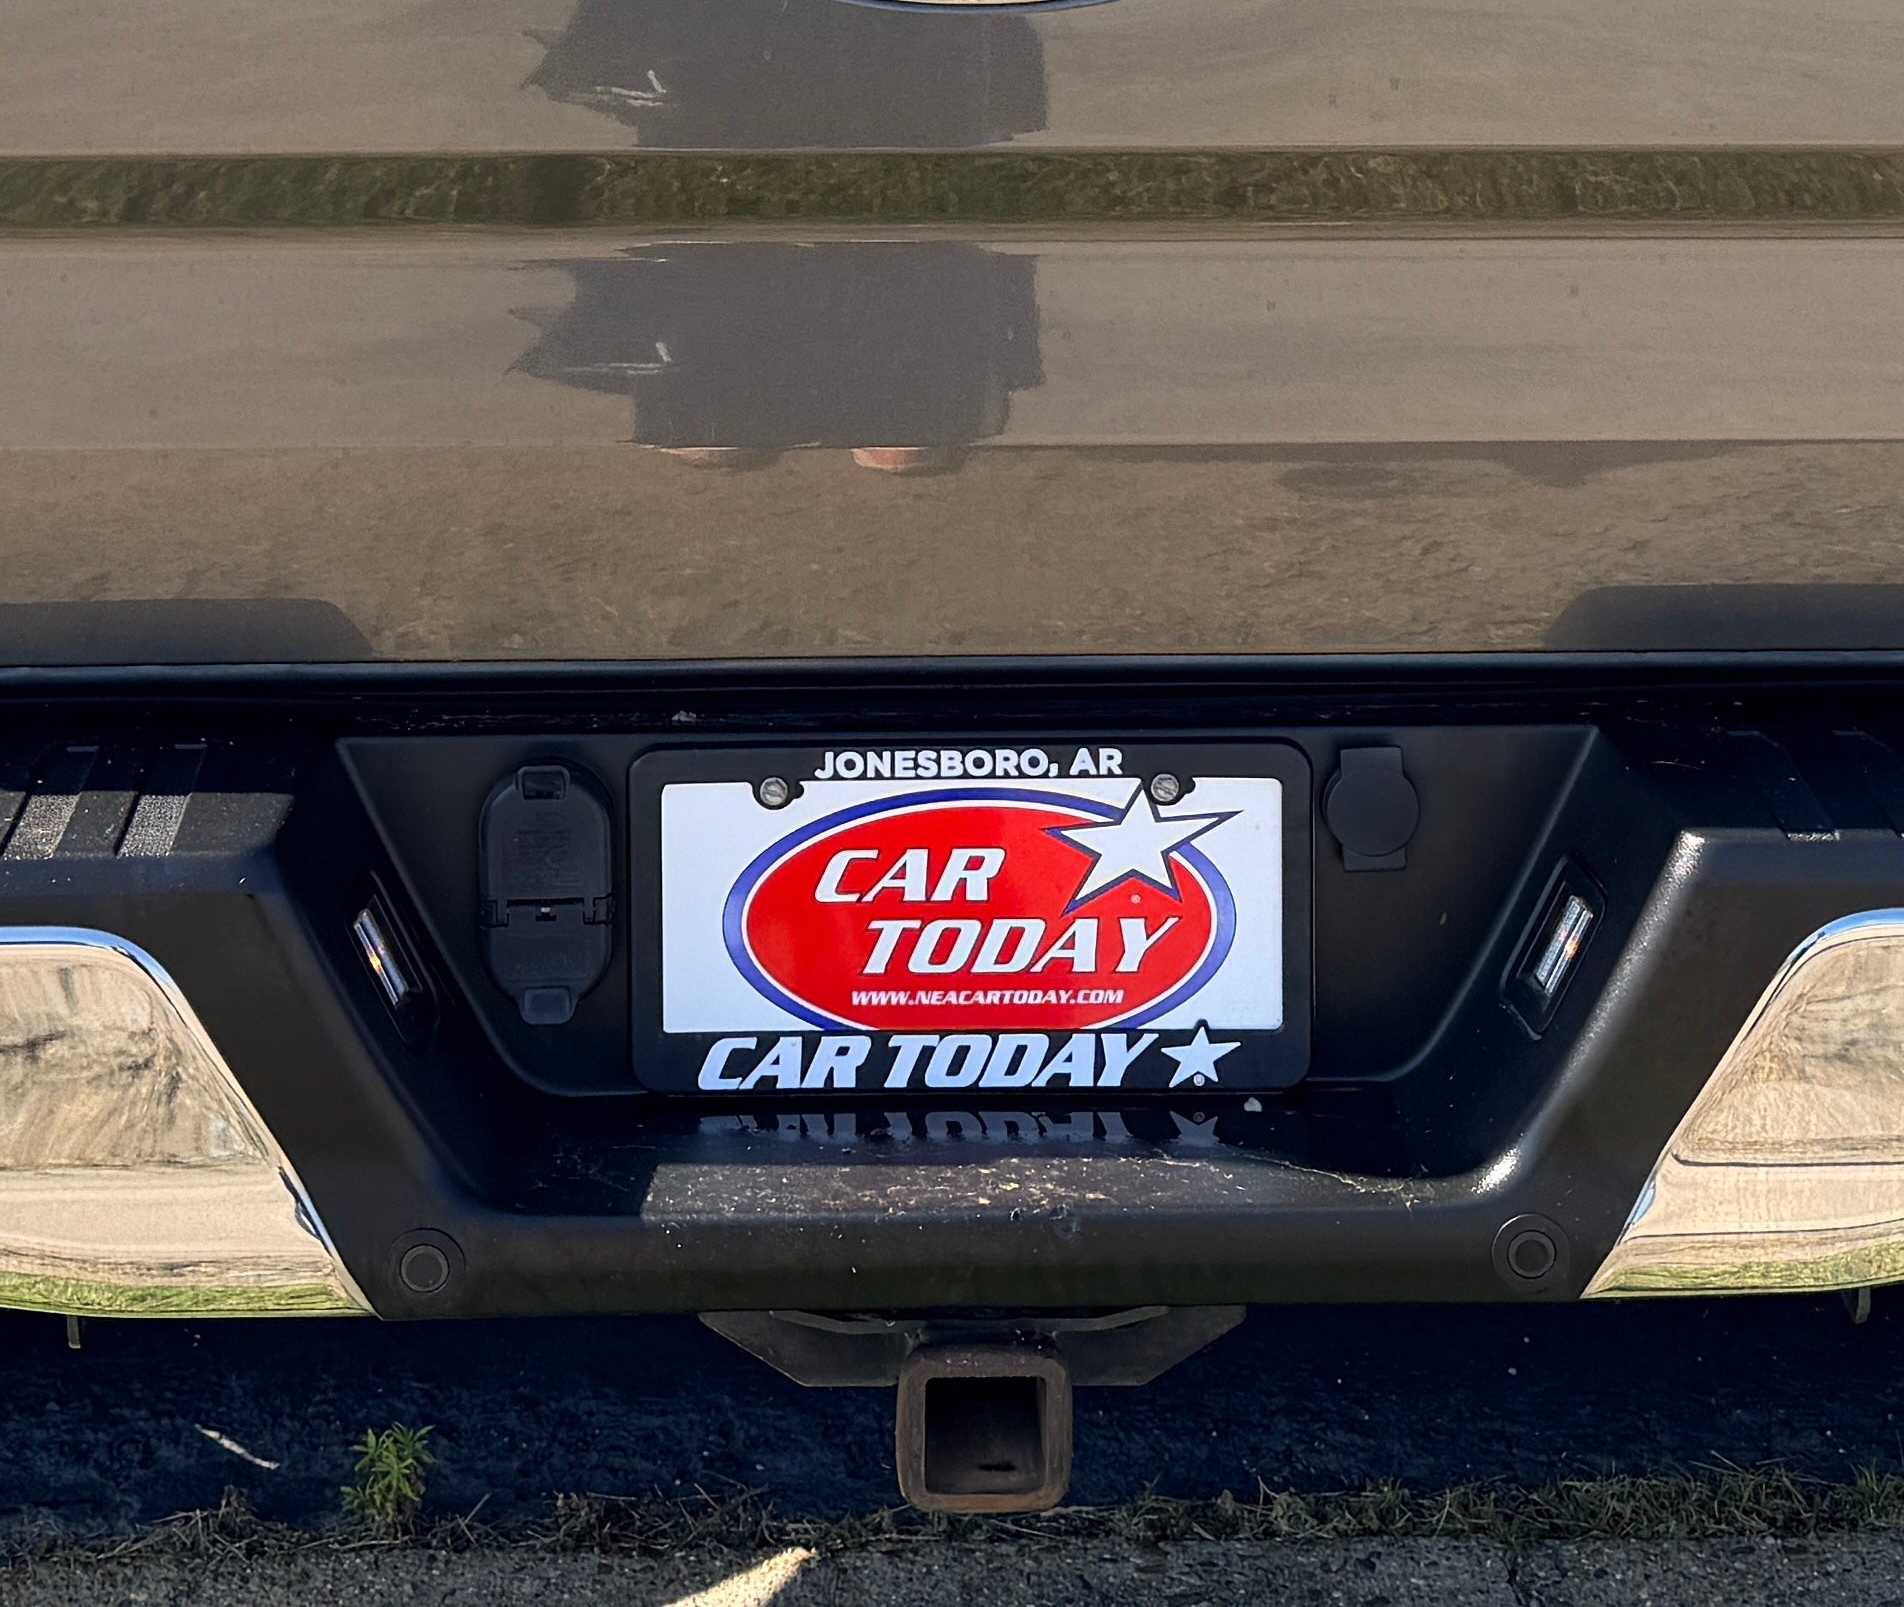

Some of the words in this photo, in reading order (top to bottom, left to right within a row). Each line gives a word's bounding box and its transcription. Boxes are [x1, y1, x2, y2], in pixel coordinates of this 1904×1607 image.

[815, 749, 1059, 780] JONESBORO,
[1070, 748, 1123, 776] AR
[815, 847, 1005, 903] CAR
[863, 917, 1182, 975] TODAY
[851, 989, 1124, 1006] WWW.NEACARTODAY.COM
[698, 1034, 872, 1091] CAR
[885, 1032, 1158, 1089] TODAY
